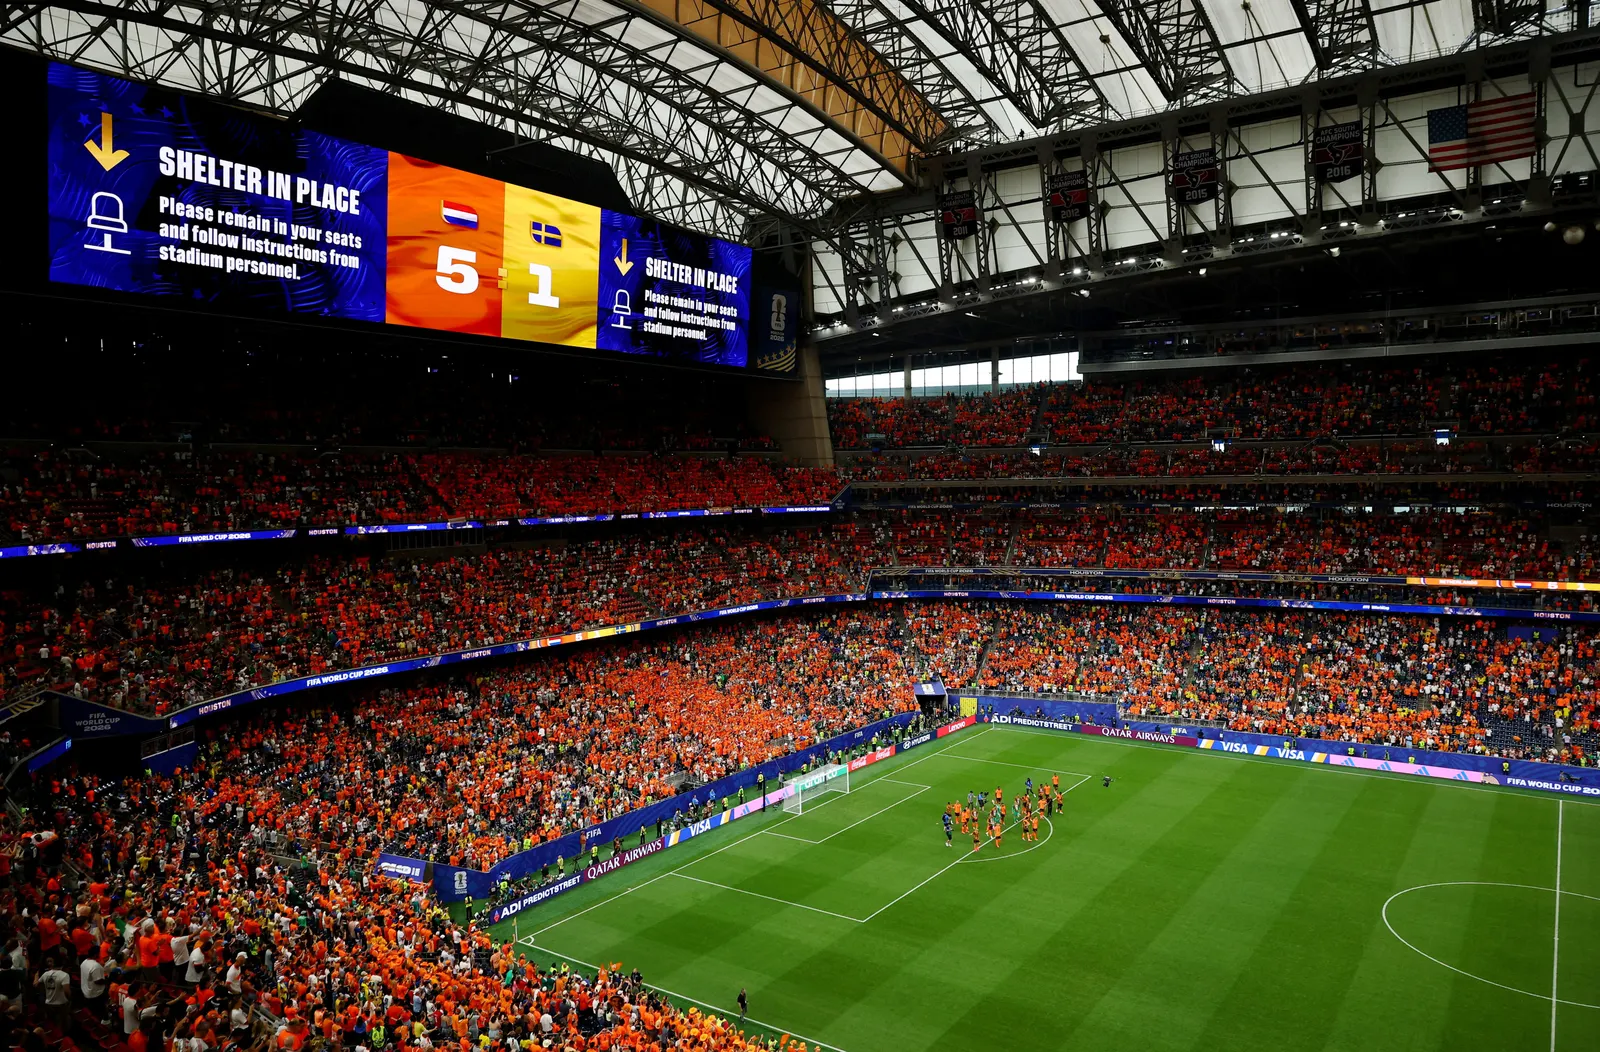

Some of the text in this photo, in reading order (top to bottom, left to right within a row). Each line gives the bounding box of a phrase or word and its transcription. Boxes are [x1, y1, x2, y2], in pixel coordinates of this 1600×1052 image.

[1316, 130, 1360, 144] CHAMPIONS
[1334, 125, 1355, 133] SOUTH
[1175, 157, 1213, 168] CHAMPIONS
[1326, 166, 1350, 178] 2016
[159, 146, 360, 216] SHELTER IN PLACE
[1051, 178, 1084, 189] CHAMPIONS
[1186, 188, 1208, 200] 2015
[1061, 208, 1080, 219] 2012
[160, 196, 362, 248] Please remain in your seats
[953, 226, 968, 235] 2011
[160, 222, 359, 268] and follow instructions from
[160, 245, 300, 280] stadium personnel.
[436, 244, 479, 294] 5
[528, 262, 560, 308] 1
[646, 256, 738, 294] SHELTER IN PLACE
[645, 289, 737, 317] Please remain in your seats
[644, 306, 735, 330] and follow instructions from
[644, 321, 708, 340] stadium personnel.
[461, 649, 491, 660] HOUSTON
[322, 673, 348, 684] WORLD
[364, 666, 388, 676] 2026
[199, 699, 231, 715] HOUSTON
[948, 721, 966, 732] Lenovo
[991, 714, 1072, 730] ADI PREDICTSTREET
[912, 734, 930, 746] HYUNDAI
[1102, 727, 1175, 744] QATAR AIRWAYS
[1220, 741, 1304, 760] VISA VISA
[1507, 778, 1526, 786] FIFA
[1528, 780, 1561, 790] WORLD
[586, 828, 601, 839] FIFA
[689, 818, 711, 836] VISA
[588, 840, 661, 879] QATAR AIRWAYS
[501, 875, 581, 919] ADI PREDICTSTREET
